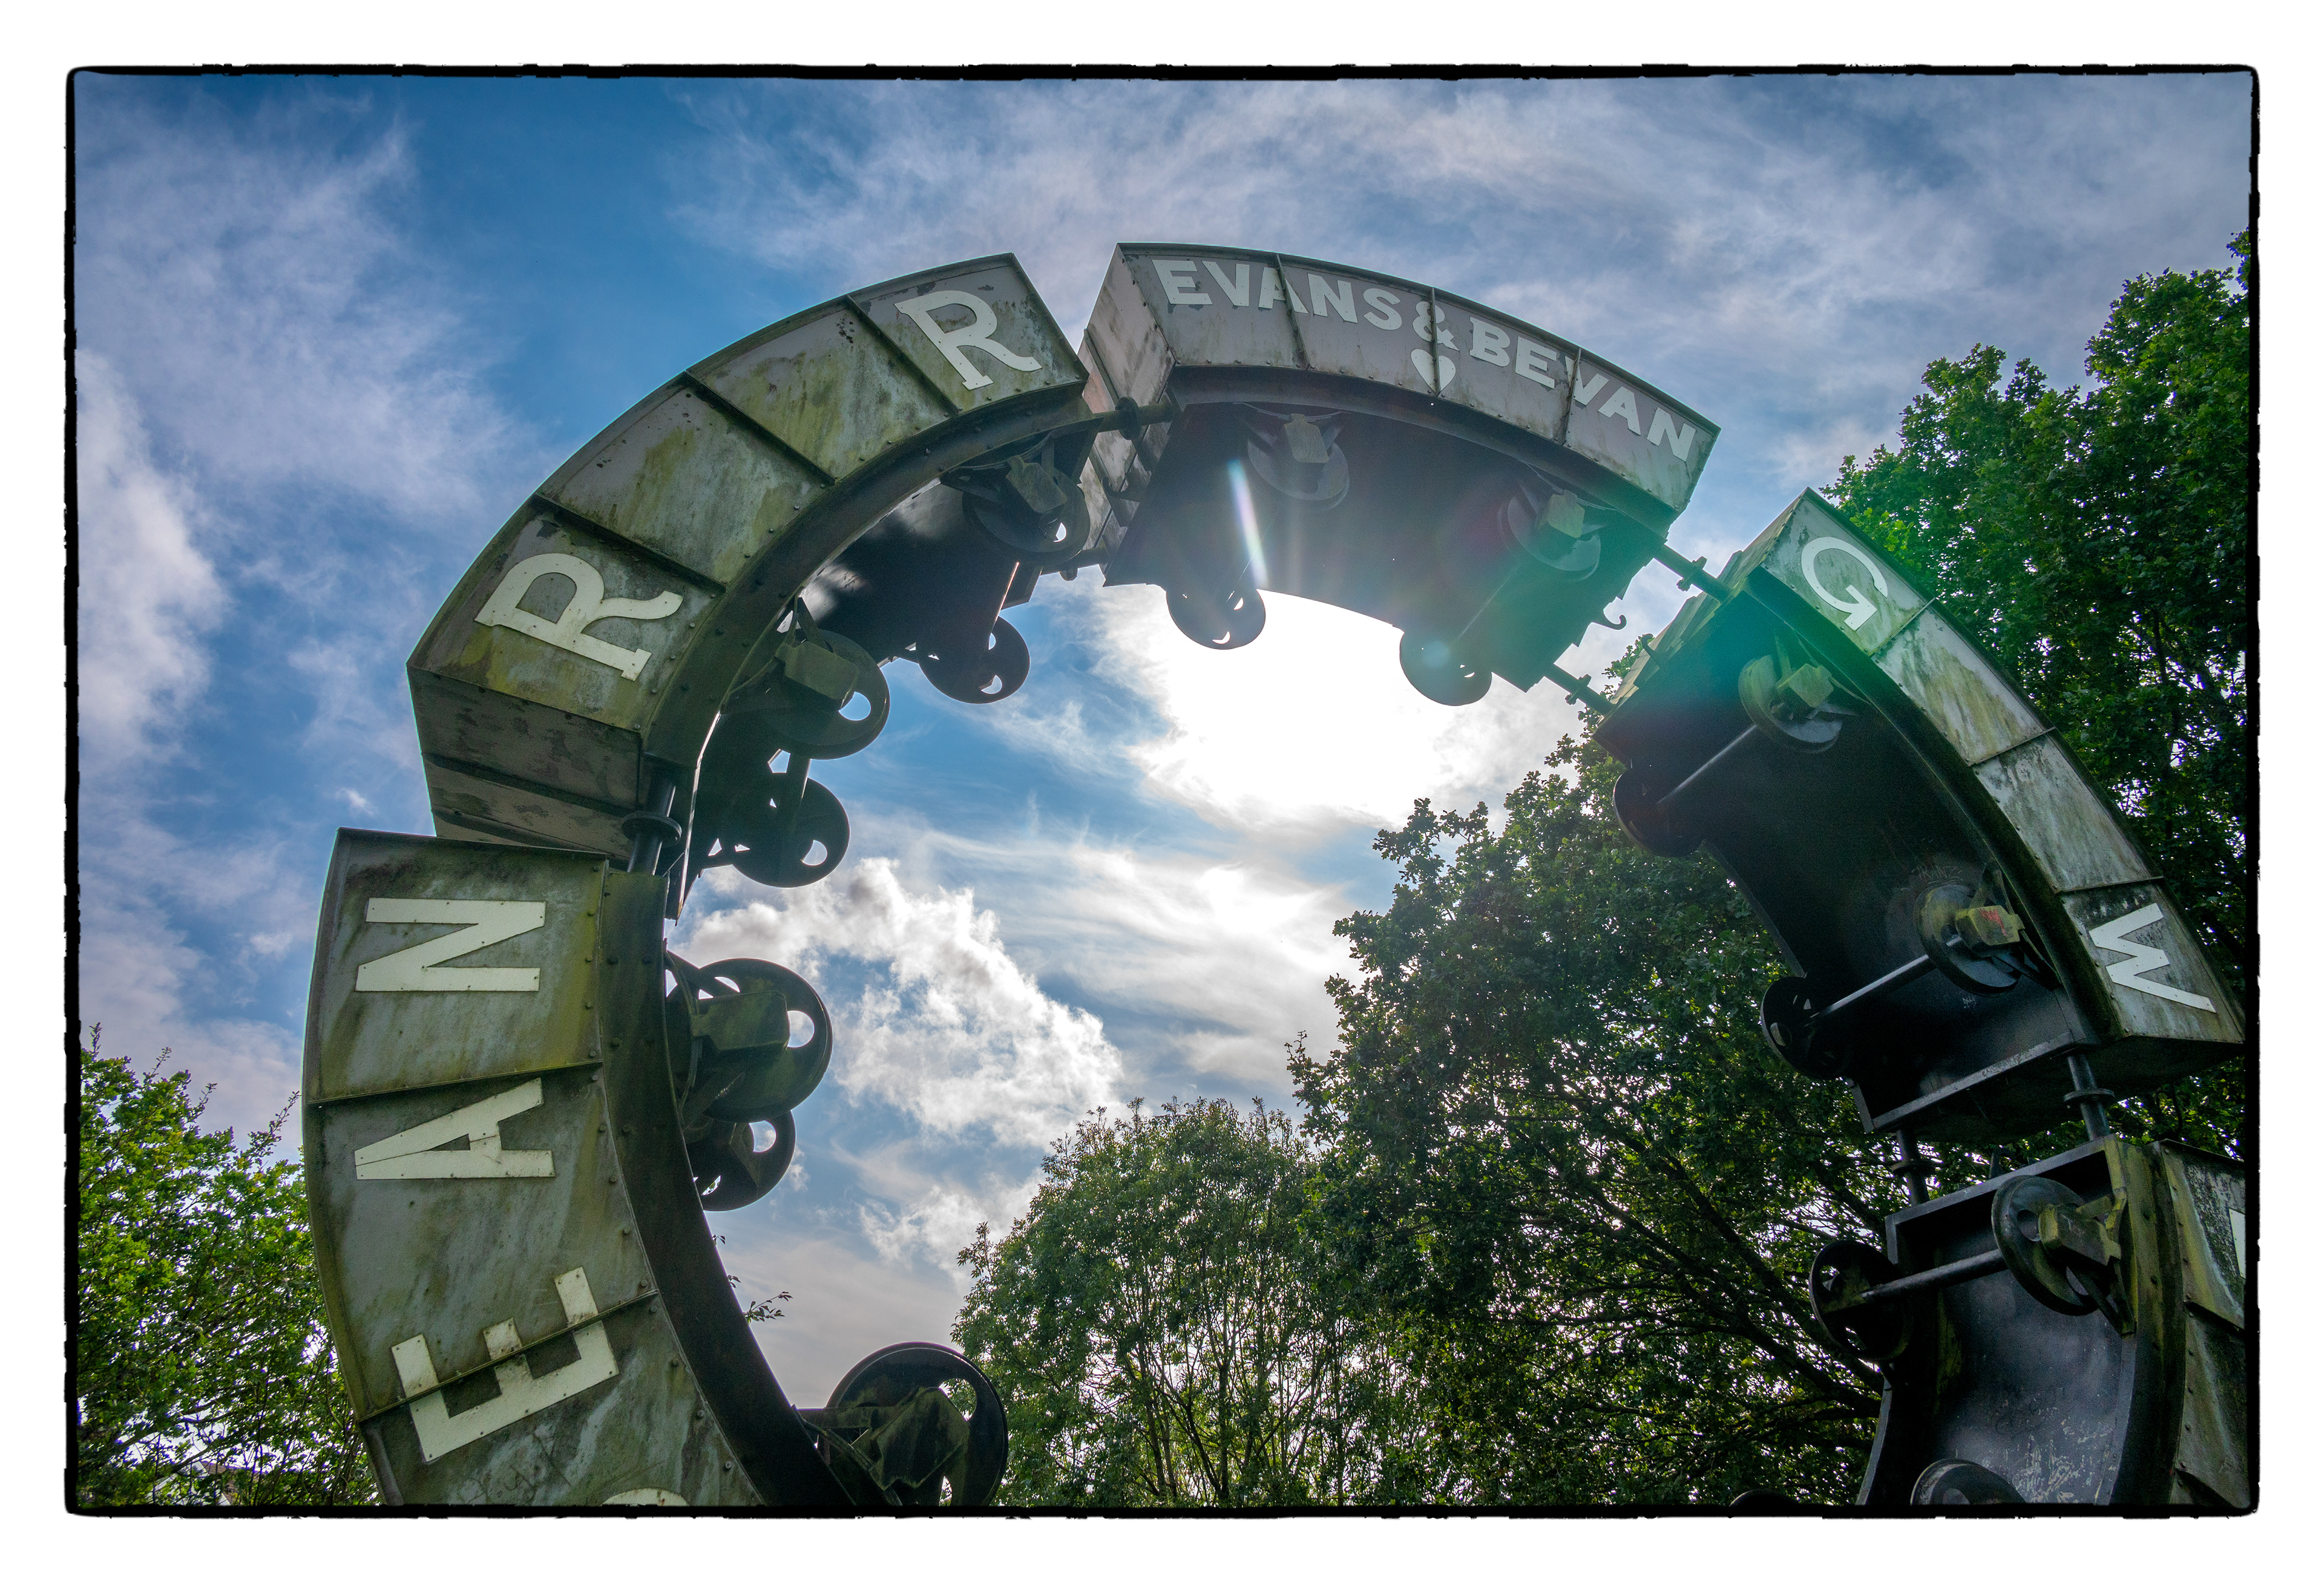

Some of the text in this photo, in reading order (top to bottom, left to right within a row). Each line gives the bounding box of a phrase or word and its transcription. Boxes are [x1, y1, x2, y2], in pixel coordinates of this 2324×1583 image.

[474, 289, 1042, 682] R R
[1151, 259, 1403, 331] EVANS
[1468, 316, 1696, 463] BEVAN
[1801, 536, 2217, 1013] G W
[355, 897, 691, 1506] EAN
